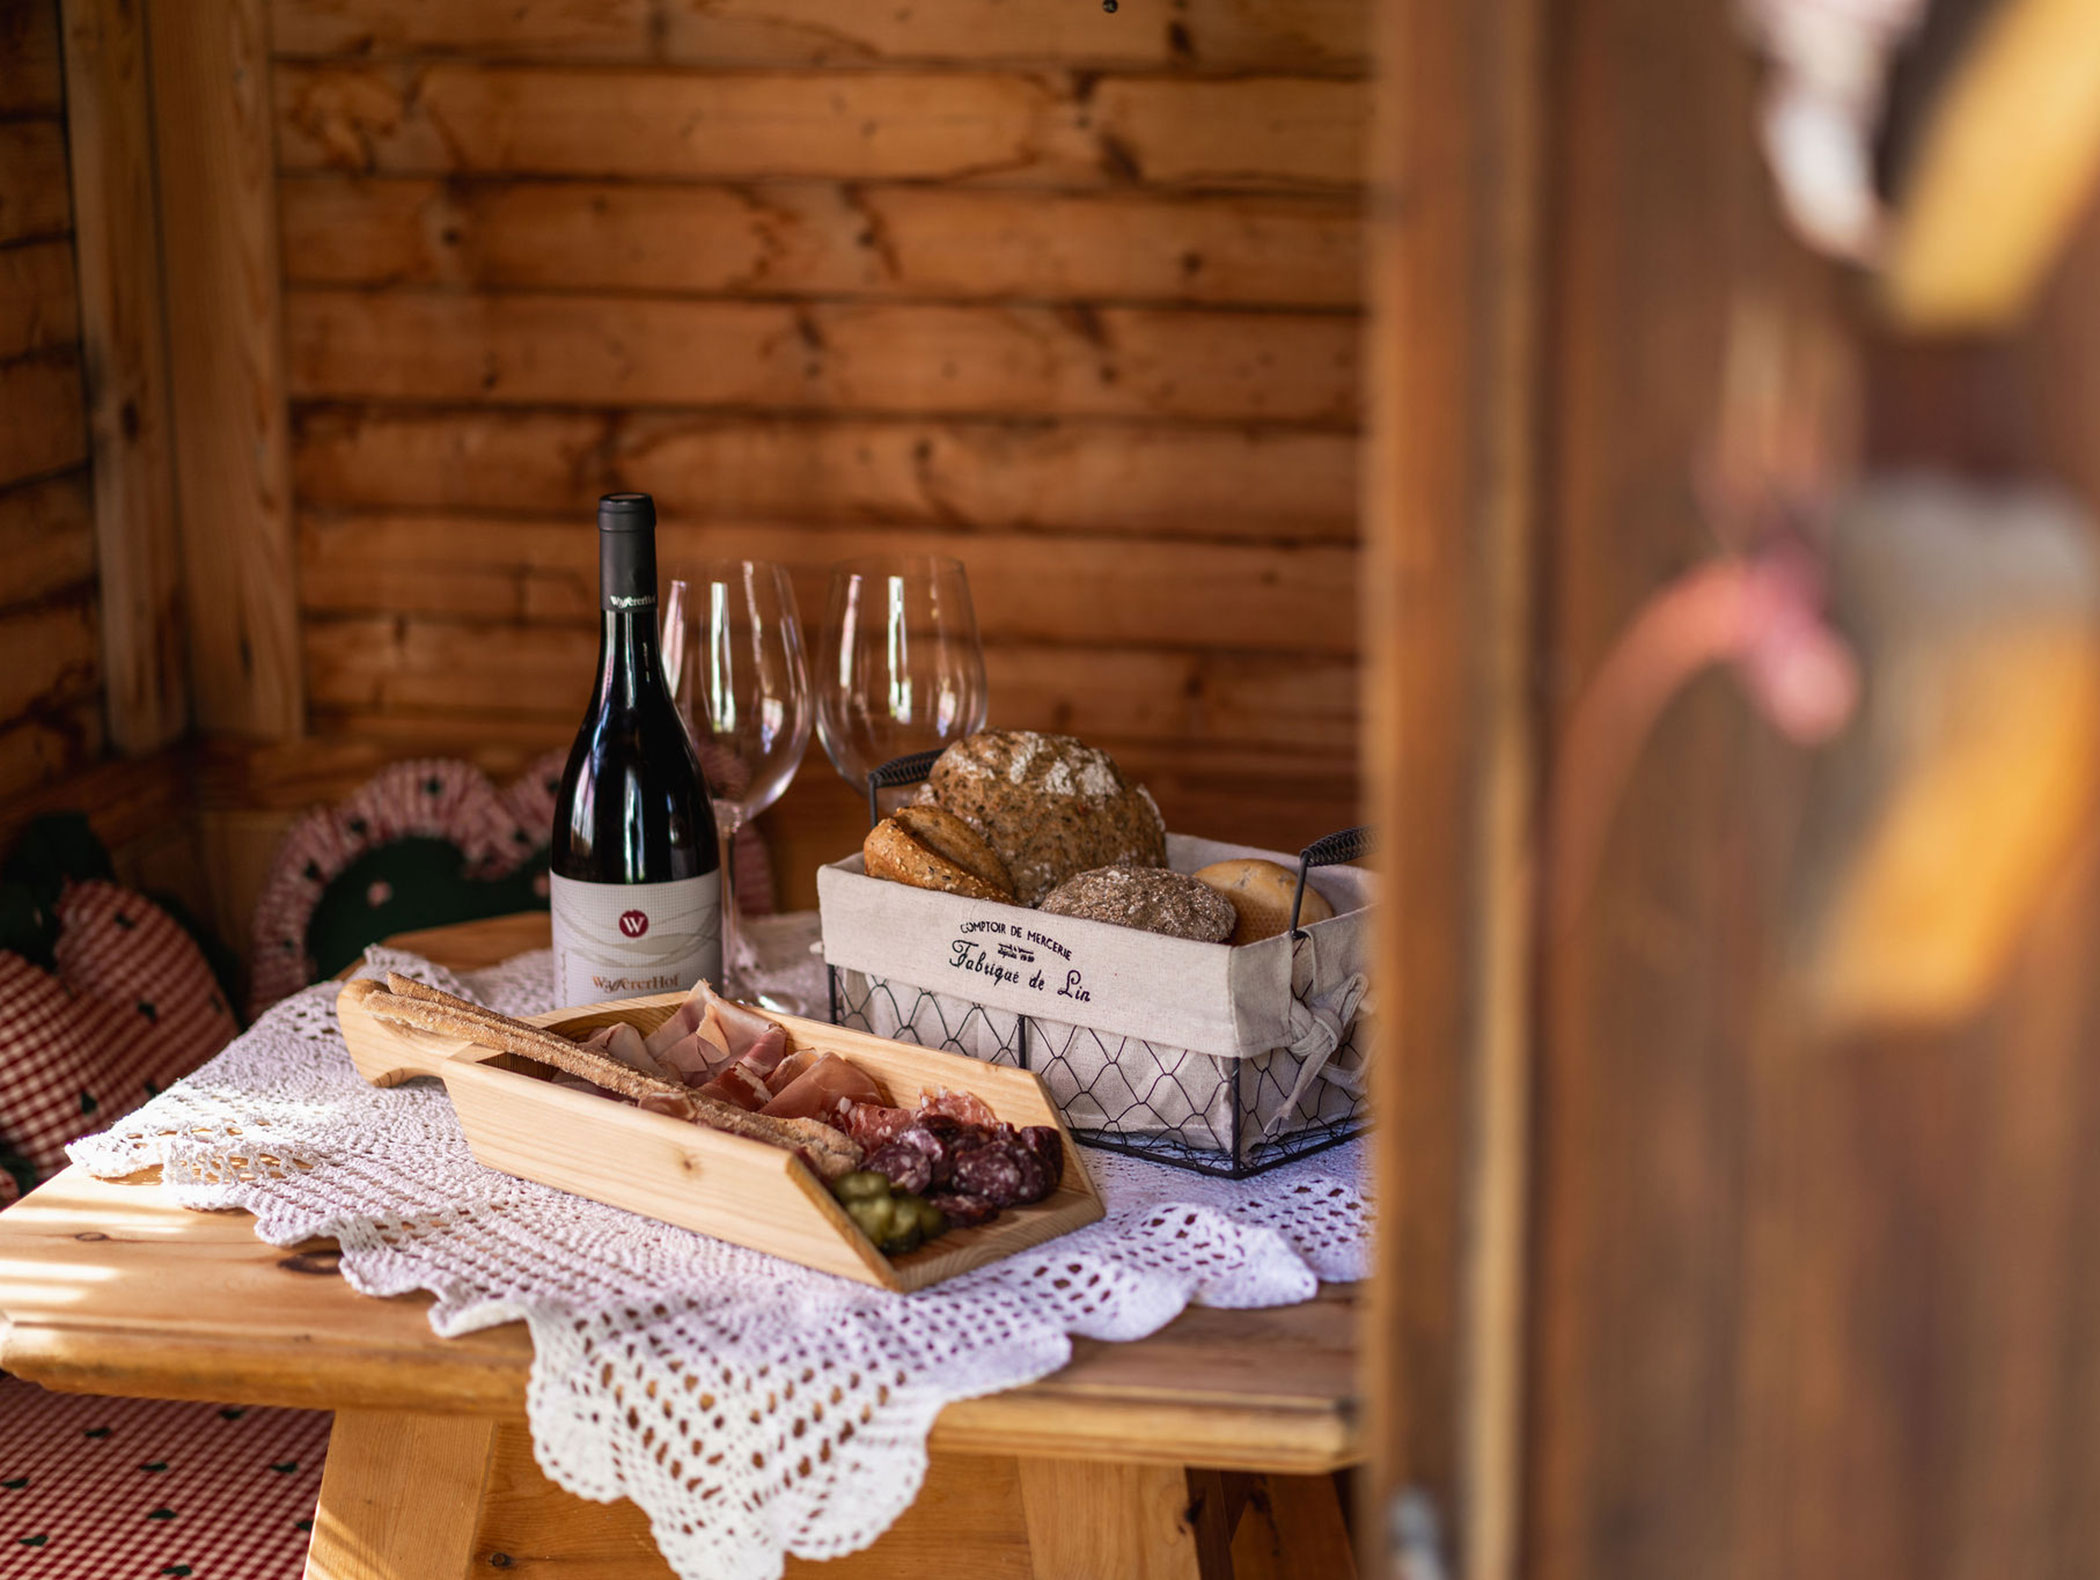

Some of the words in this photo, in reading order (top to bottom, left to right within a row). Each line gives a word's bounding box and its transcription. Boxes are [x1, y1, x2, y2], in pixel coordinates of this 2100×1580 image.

[622, 916, 646, 933] W
[960, 920, 1006, 934] COMPTOIR
[1010, 925, 1022, 938] DE
[1027, 930, 1073, 961] MERCERIE
[1028, 969, 1045, 991] de
[1057, 969, 1091, 1002] Lin
